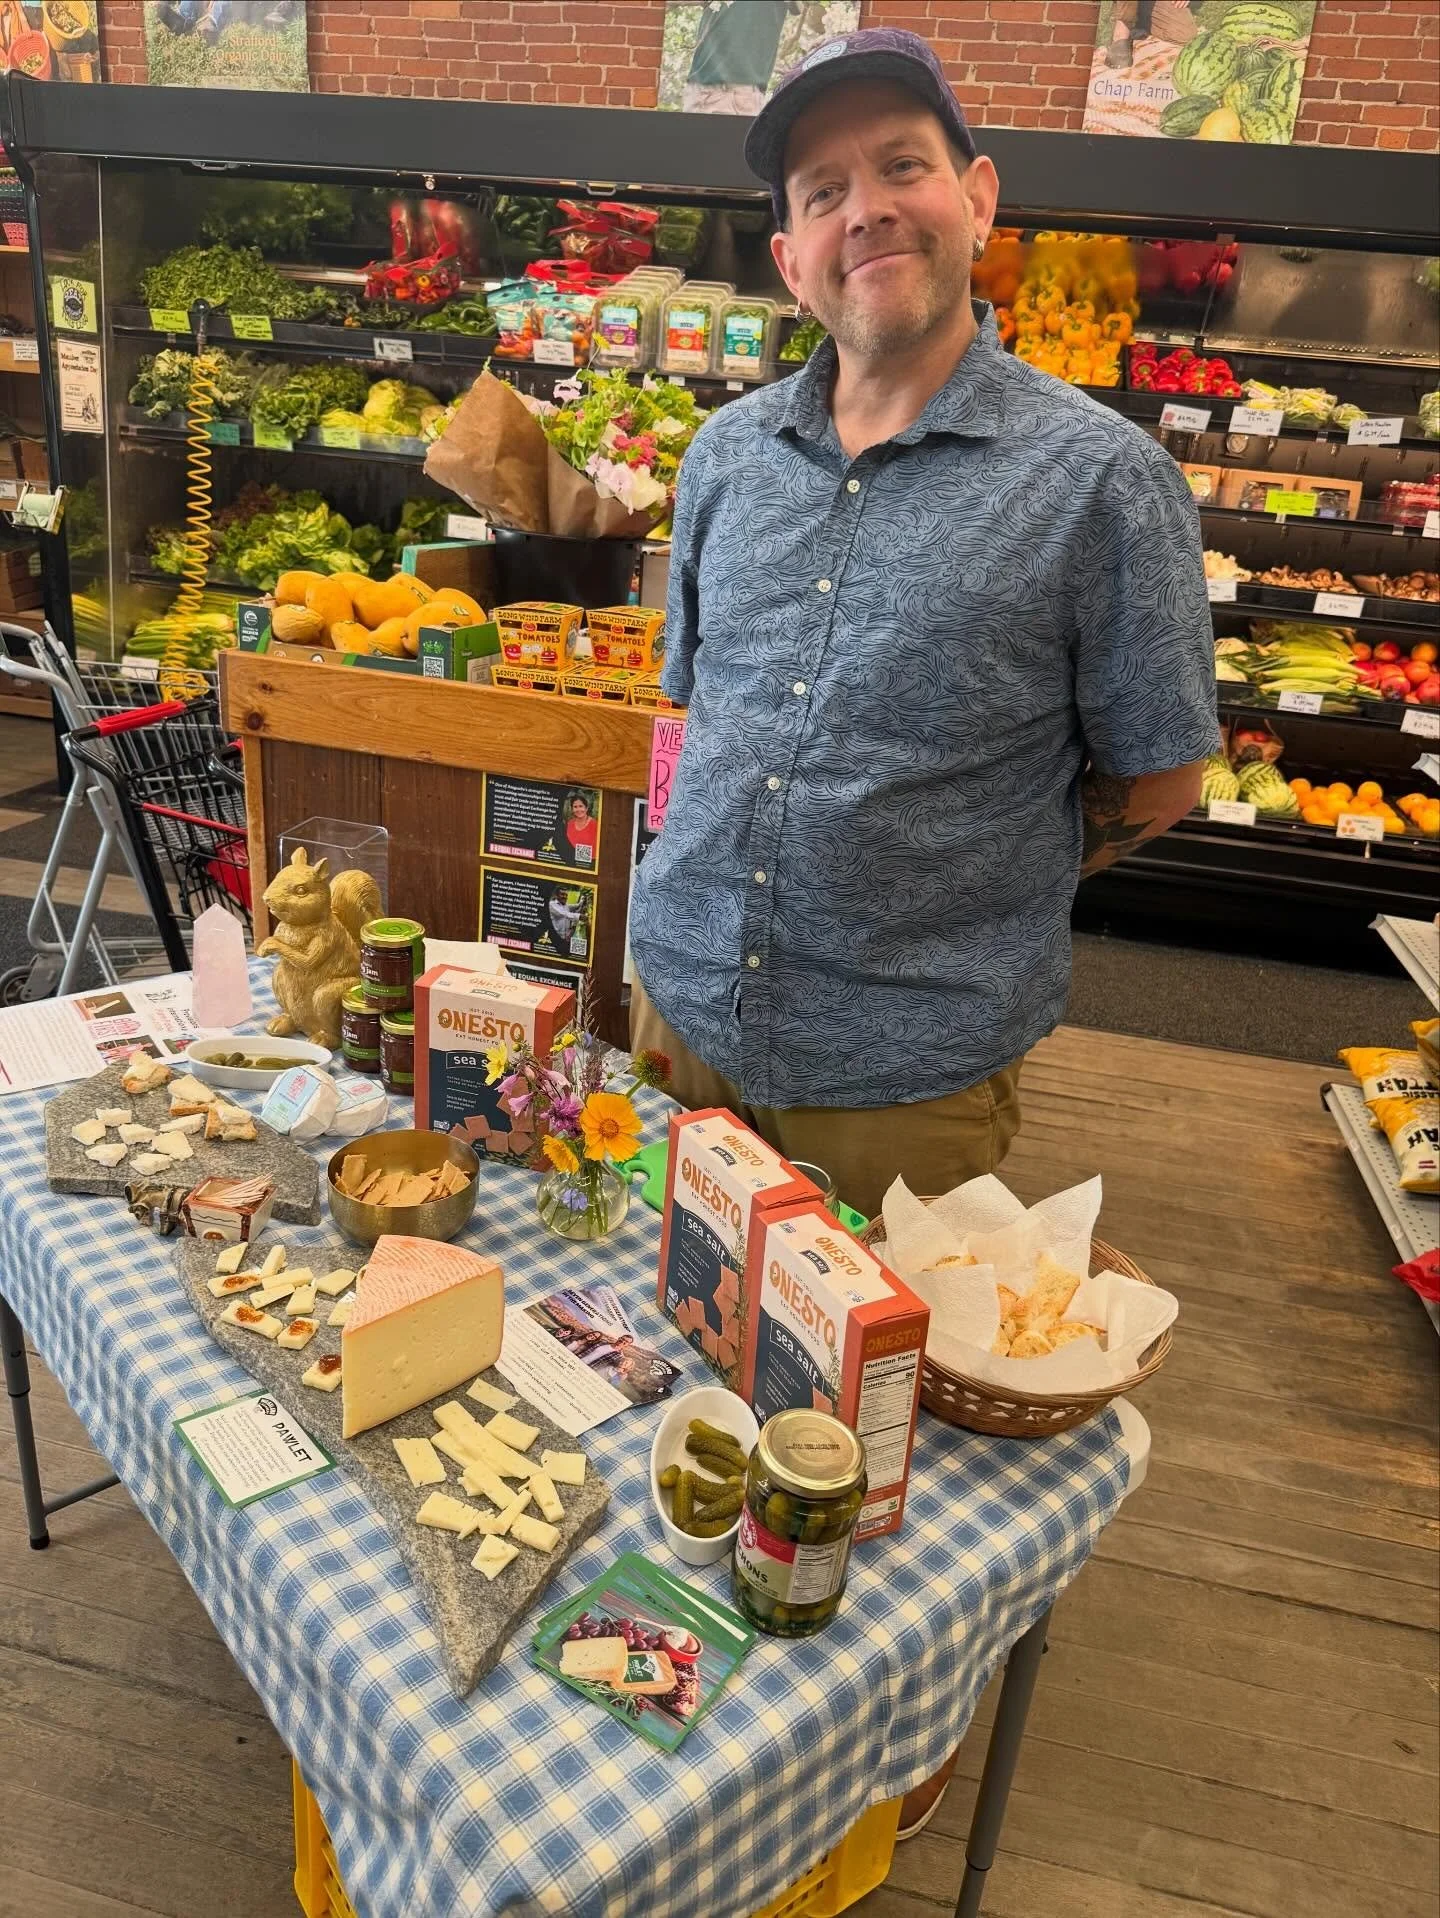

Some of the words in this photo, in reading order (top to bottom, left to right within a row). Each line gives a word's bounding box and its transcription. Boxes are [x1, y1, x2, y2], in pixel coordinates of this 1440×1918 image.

[229, 35, 276, 46] Strafford
[216, 50, 257, 62] Organic
[261, 50, 289, 63] Dairy
[1094, 80, 1132, 101] Chap
[1139, 82, 1174, 99] Farm
[498, 612, 517, 620] LONG
[518, 614, 538, 622] WIND
[540, 615, 562, 624] FARM
[589, 613, 607, 622] LONG
[608, 615, 626, 624] WIND
[628, 618, 648, 627] FARM
[518, 632, 560, 644] TOMATOES
[606, 635, 646, 646] TOMATOES
[496, 669, 514, 677] LONG
[515, 670, 535, 679] WIND
[536, 673, 557, 683] FARM
[564, 678, 583, 687] LONG
[584, 680, 603, 690] WIND
[605, 683, 626, 693] FARM
[634, 688, 653, 696] LONG
[658, 722, 683, 750] VE
[651, 815, 663, 825] FO
[518, 973, 538, 982] EQUAL
[540, 977, 573, 988] EXCHANGE
[438, 1008, 525, 1043] ONESTO
[468, 1035, 491, 1043] HONEST
[454, 1056, 476, 1065] sea
[1401, 1090, 1440, 1098] LASSIC
[722, 1135, 765, 1166] ONESTO
[682, 1157, 742, 1230] ONESTO
[687, 1218, 704, 1238] sea
[707, 1233, 726, 1262] salt
[815, 1237, 862, 1276] ONESTO
[769, 1260, 836, 1348] ONESTO
[582, 1300, 613, 1326] GENERATIONS
[865, 1327, 920, 1352] ONESTO
[776, 1328, 794, 1351] sea
[797, 1351, 818, 1383] salt
[865, 1358, 896, 1370] Nutrition
[898, 1353, 916, 1361] Facts
[906, 1371, 914, 1379] 90
[863, 1380, 886, 1389] Calories
[272, 1422, 312, 1462] PAWLET
